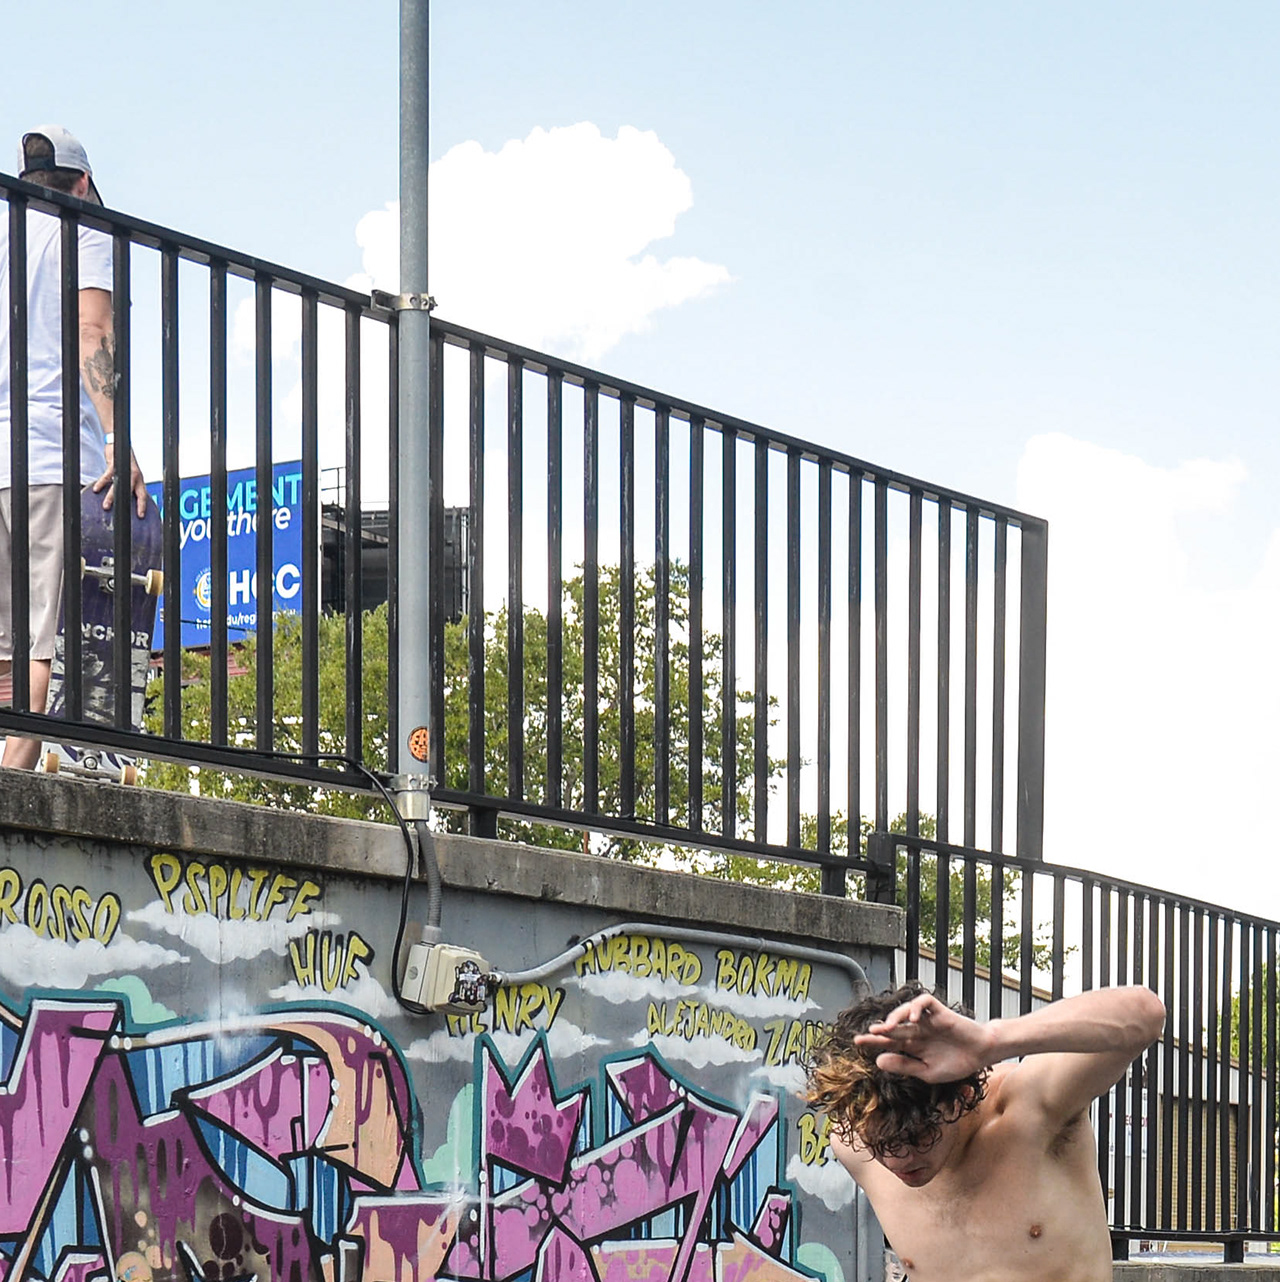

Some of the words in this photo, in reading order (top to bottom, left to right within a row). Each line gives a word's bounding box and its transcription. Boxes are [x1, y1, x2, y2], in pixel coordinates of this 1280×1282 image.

[290, 929, 373, 993] HUF
[574, 931, 704, 986] HUBBARD
[716, 949, 812, 1001] BOKMA
[647, 999, 757, 1052] ALEJANDRO
